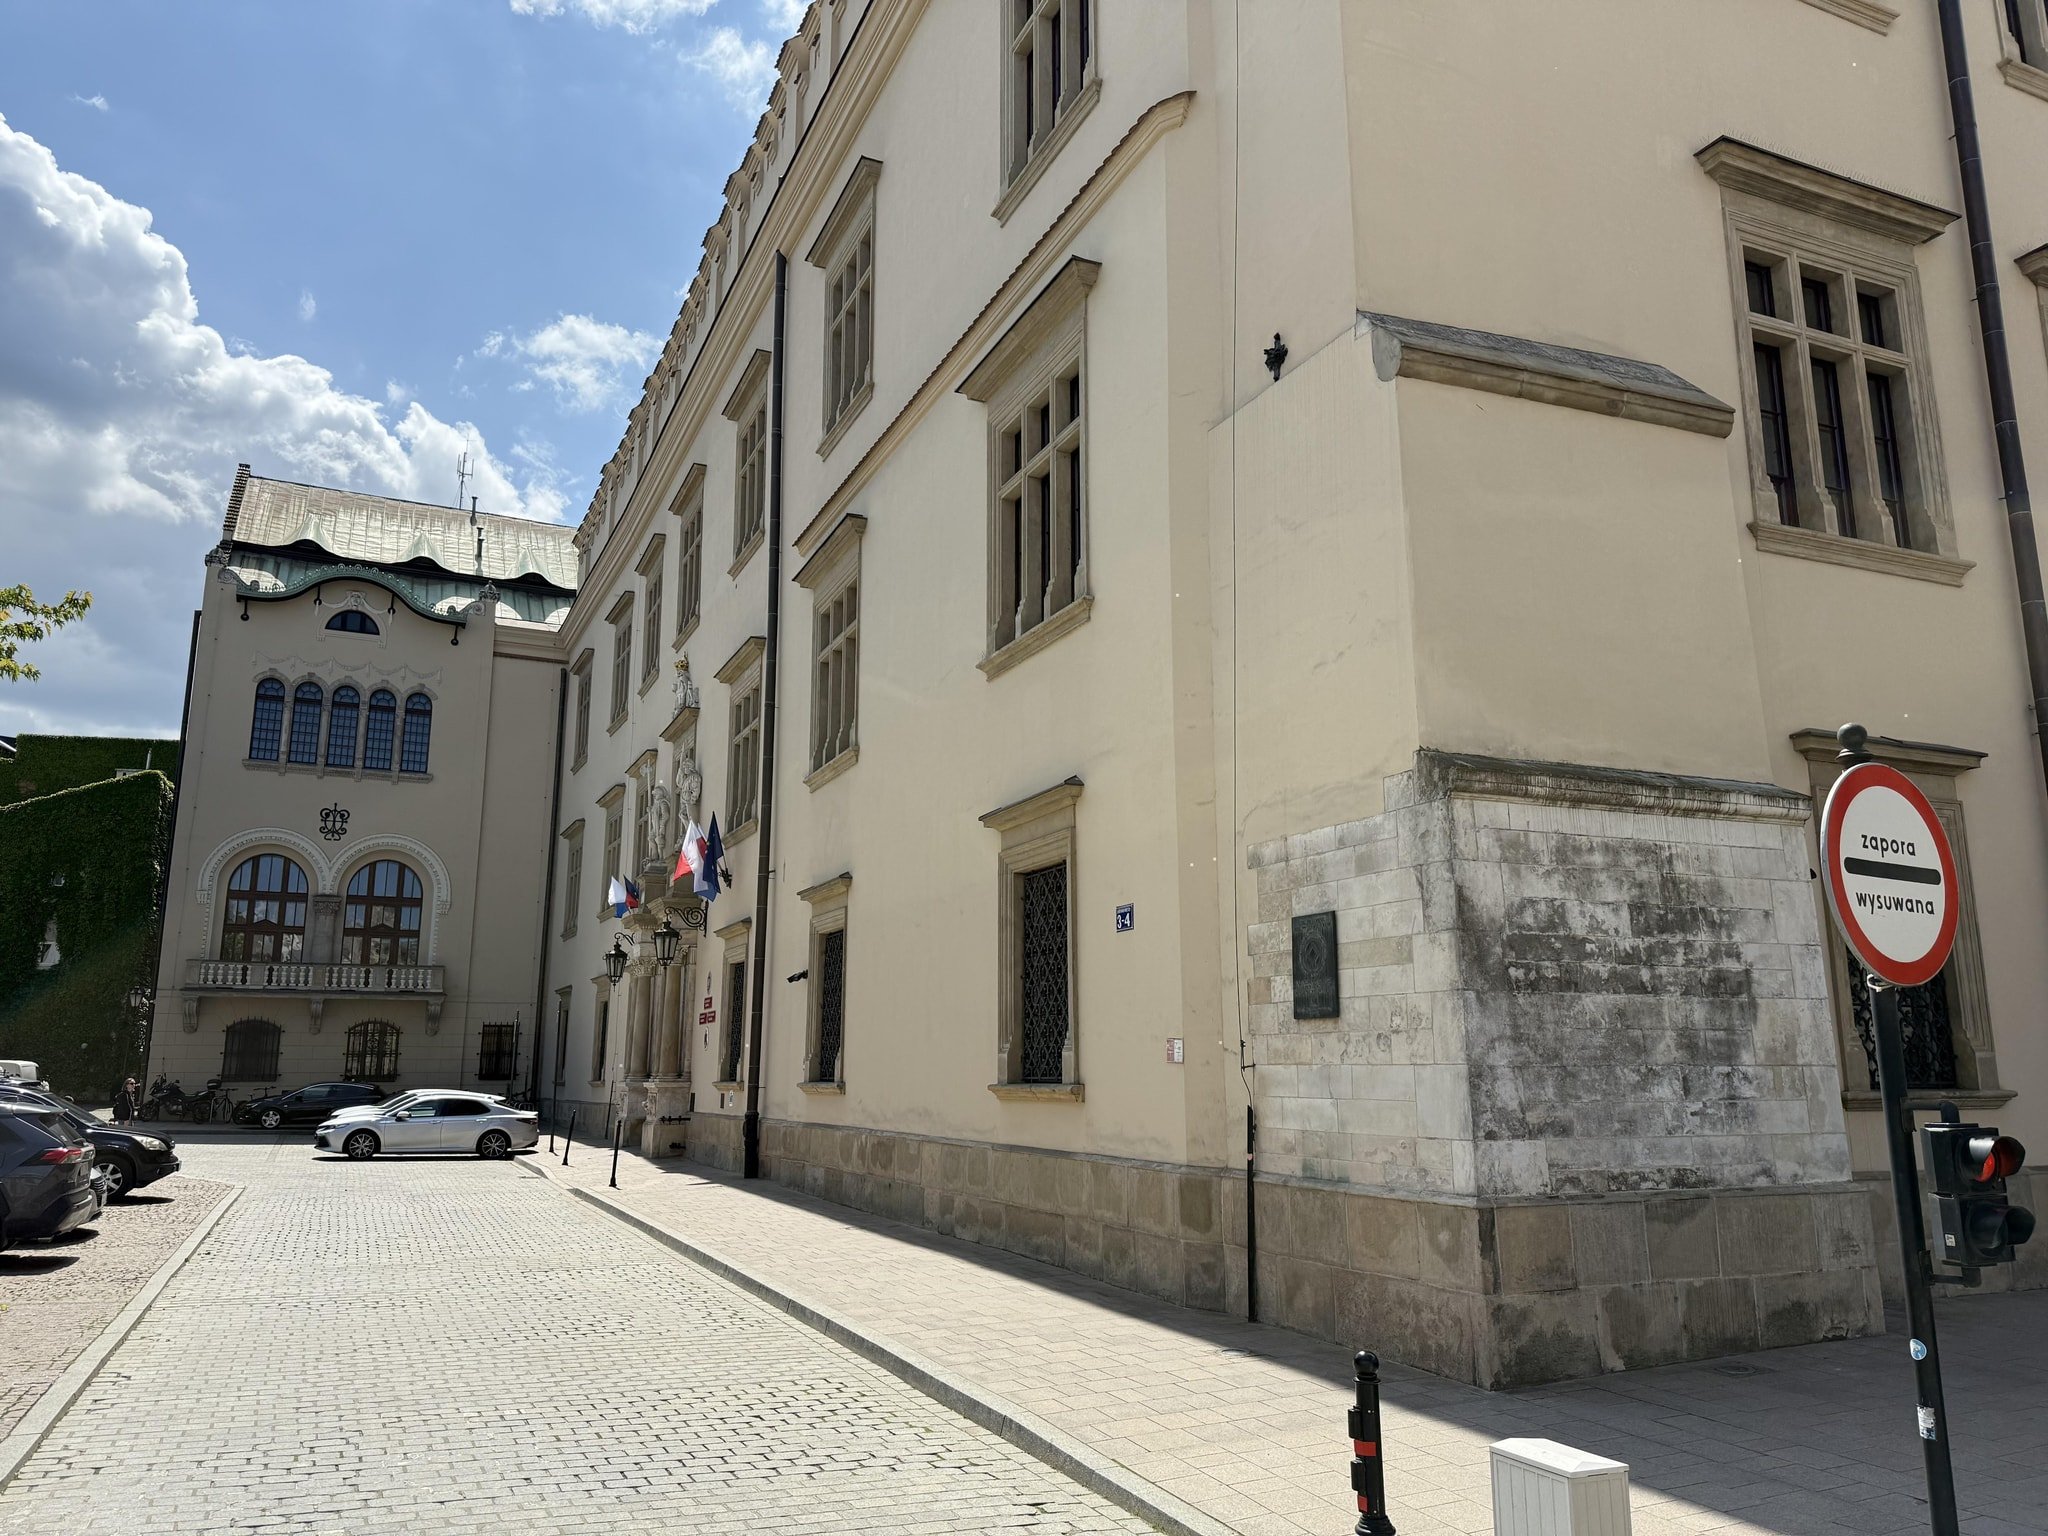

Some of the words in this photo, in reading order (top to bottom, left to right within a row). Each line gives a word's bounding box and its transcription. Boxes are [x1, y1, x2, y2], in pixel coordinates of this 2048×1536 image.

[1861, 833, 1916, 858] zapora
[1856, 892, 1935, 915] wysuwana
[1117, 913, 1130, 928] 3-4
